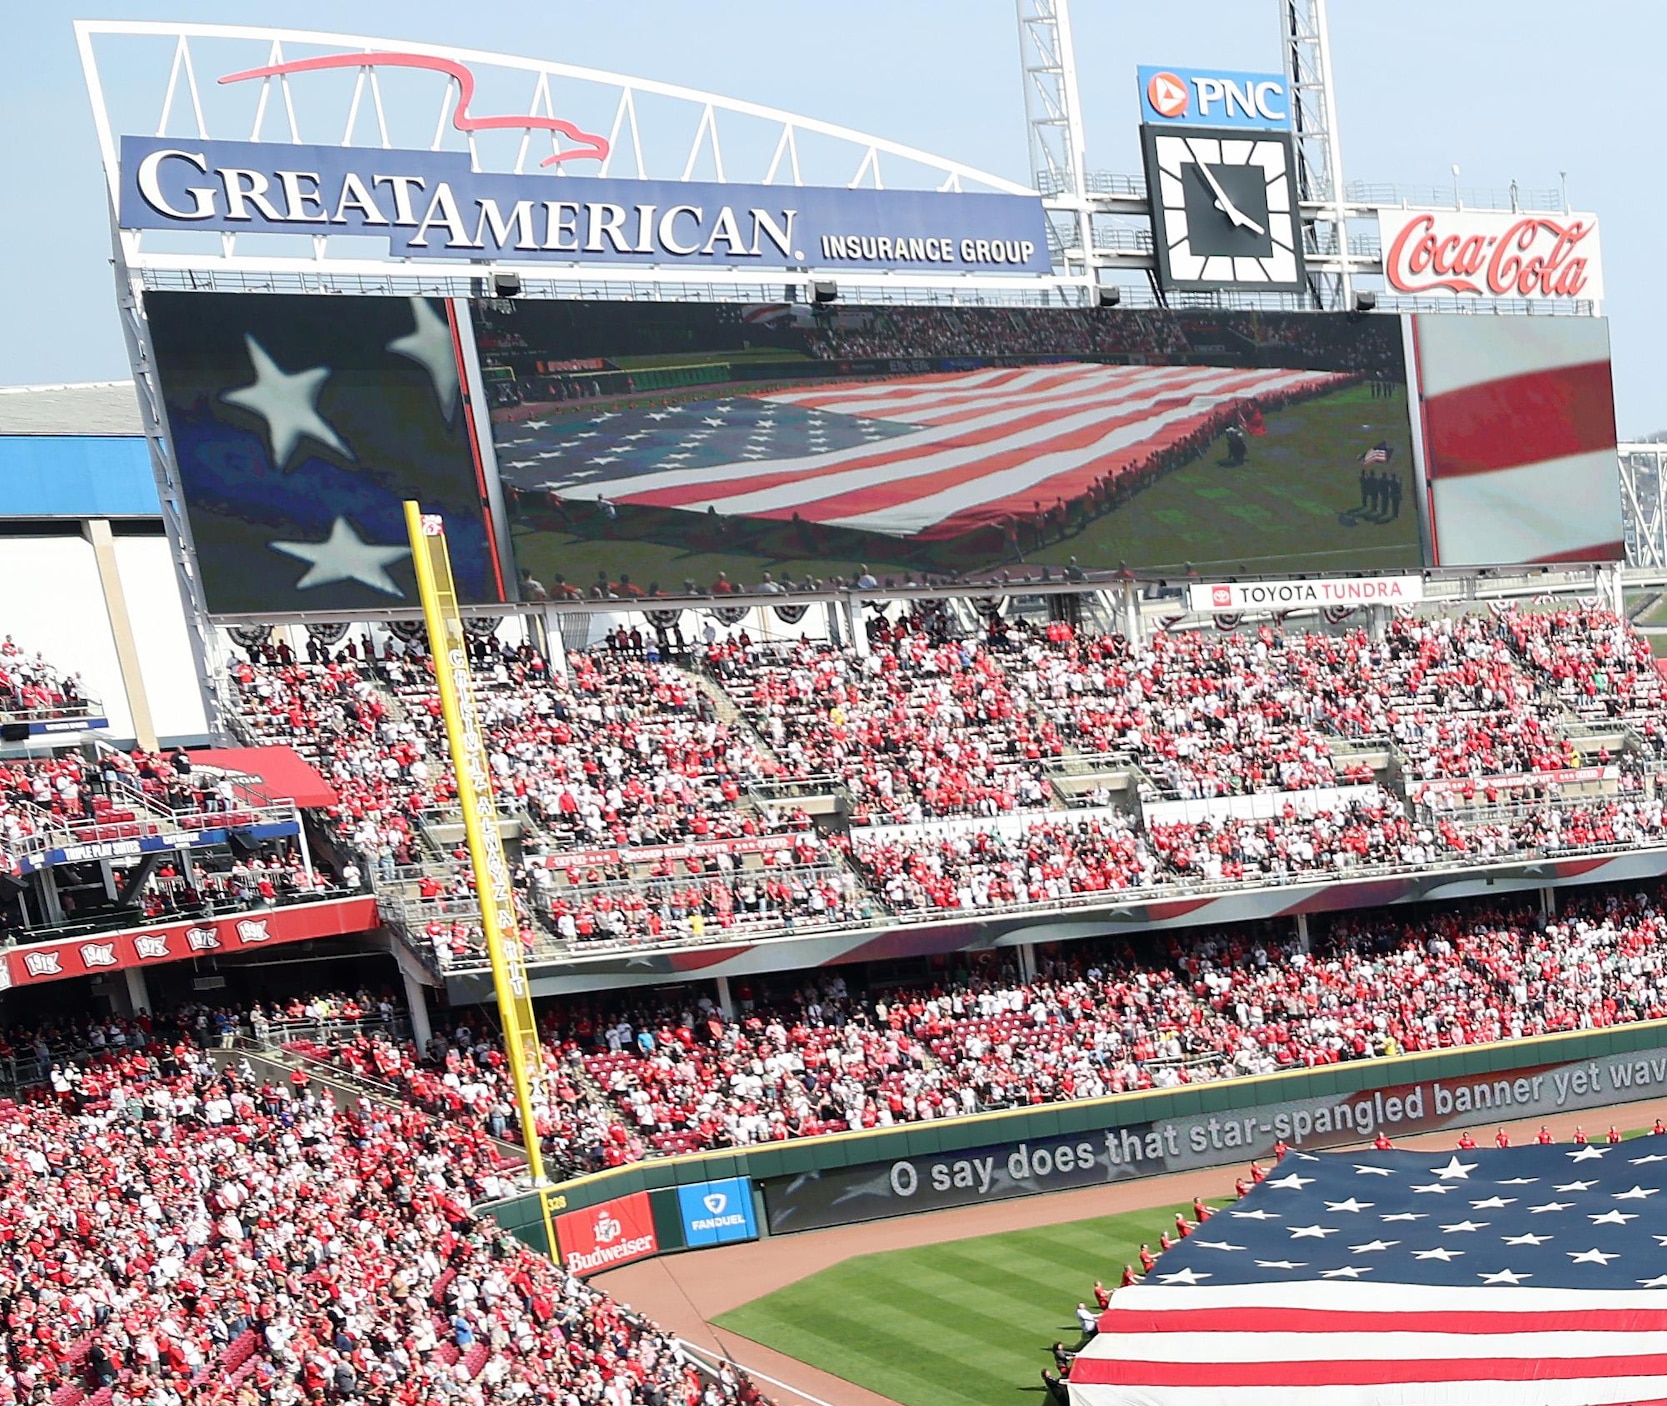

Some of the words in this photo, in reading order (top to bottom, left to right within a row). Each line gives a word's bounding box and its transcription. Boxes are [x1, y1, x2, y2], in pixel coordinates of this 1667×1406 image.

[1191, 77, 1286, 122] PNC
[822, 234, 954, 263] INSURANCE
[960, 239, 1036, 264] GROUP
[1387, 214, 1597, 297] Coca-Cola
[1240, 585, 1317, 602] TOYOTA
[1322, 581, 1402, 600] TUNDRA
[64, 844, 91, 861] TRIPLE
[92, 842, 111, 858] PLAY
[890, 1160, 918, 1198] O
[930, 1155, 995, 1194] say
[1006, 1142, 1096, 1181] does
[1104, 1124, 1180, 1165] that
[1189, 1086, 1425, 1153] star-spangled
[1433, 1076, 1544, 1117] banner
[1554, 1062, 1602, 1106] yet
[547, 1196, 568, 1212] 328
[691, 1214, 746, 1231] FANDUEL
[566, 1234, 654, 1274] Budweiser
